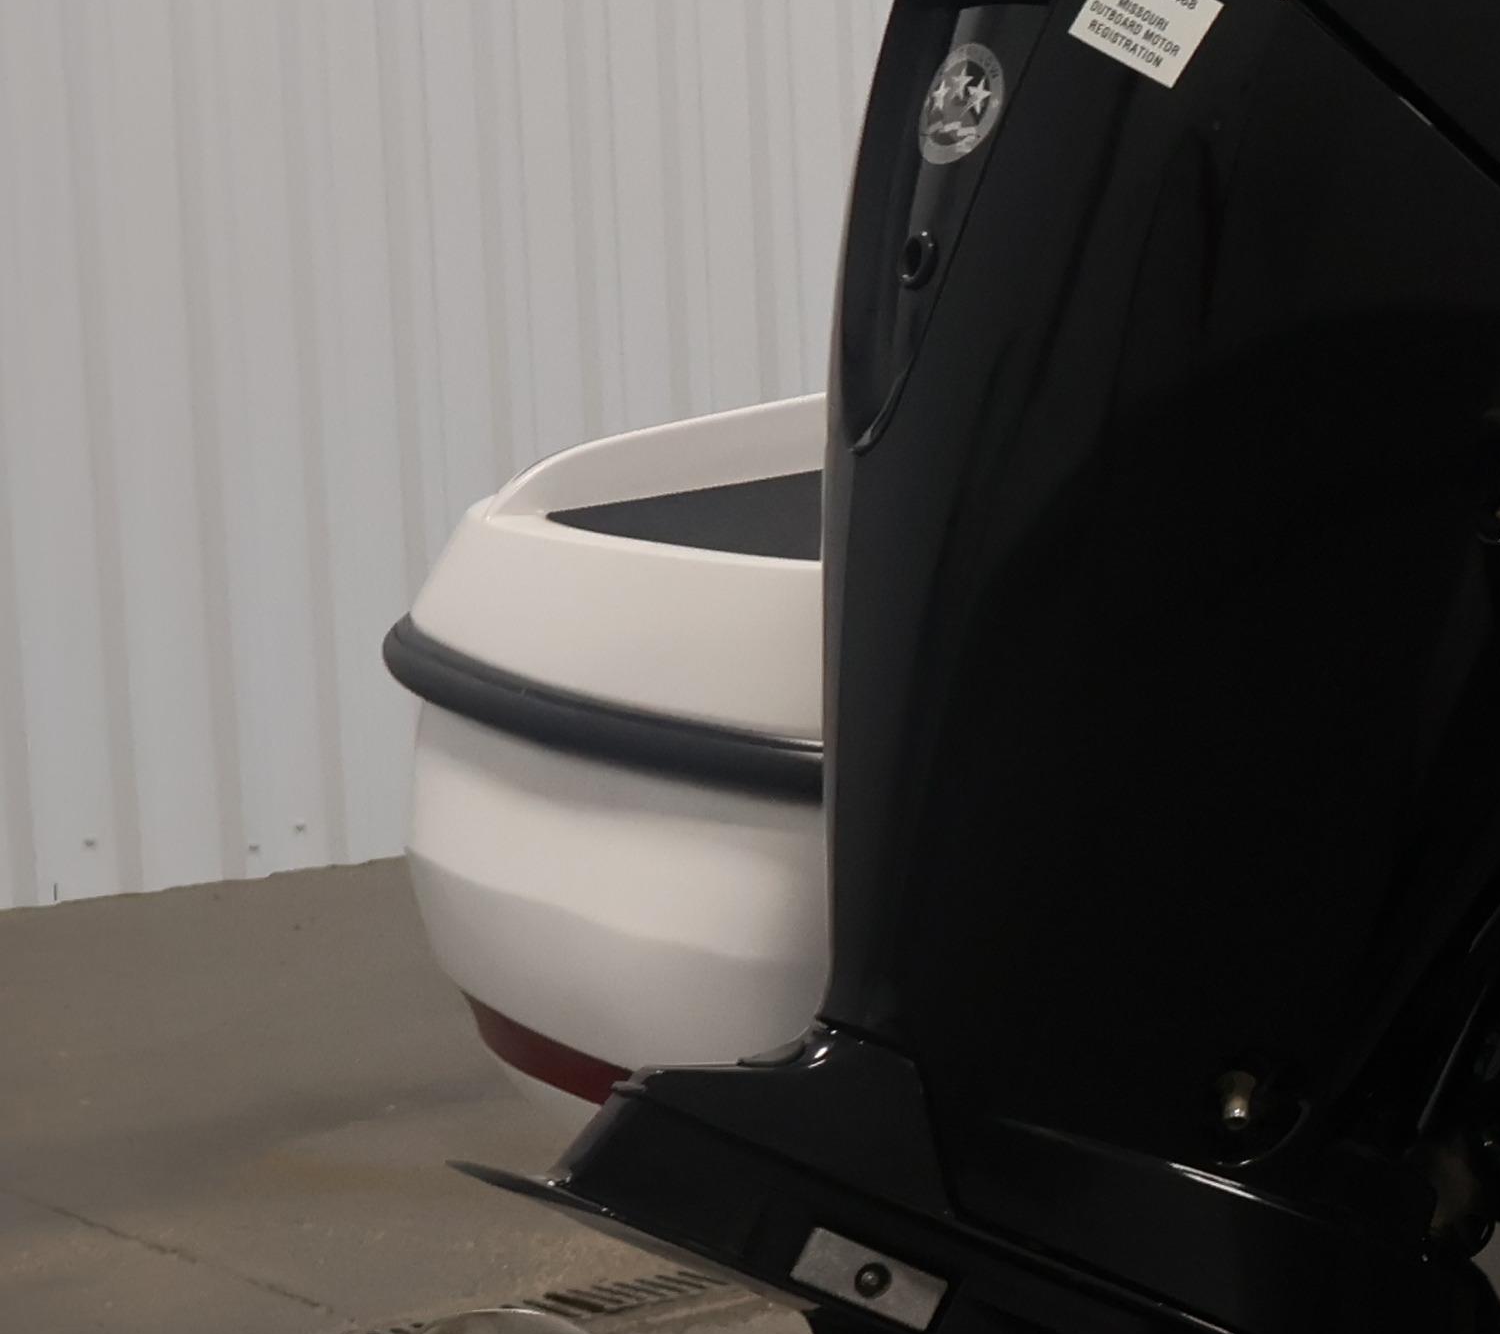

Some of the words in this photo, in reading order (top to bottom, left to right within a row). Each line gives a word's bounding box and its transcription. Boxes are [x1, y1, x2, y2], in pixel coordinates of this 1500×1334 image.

[1088, 19, 1163, 68] REGISTRATION
[1090, 0, 1144, 34] OUTBOARD
[1143, 29, 1181, 57] MOTOR
